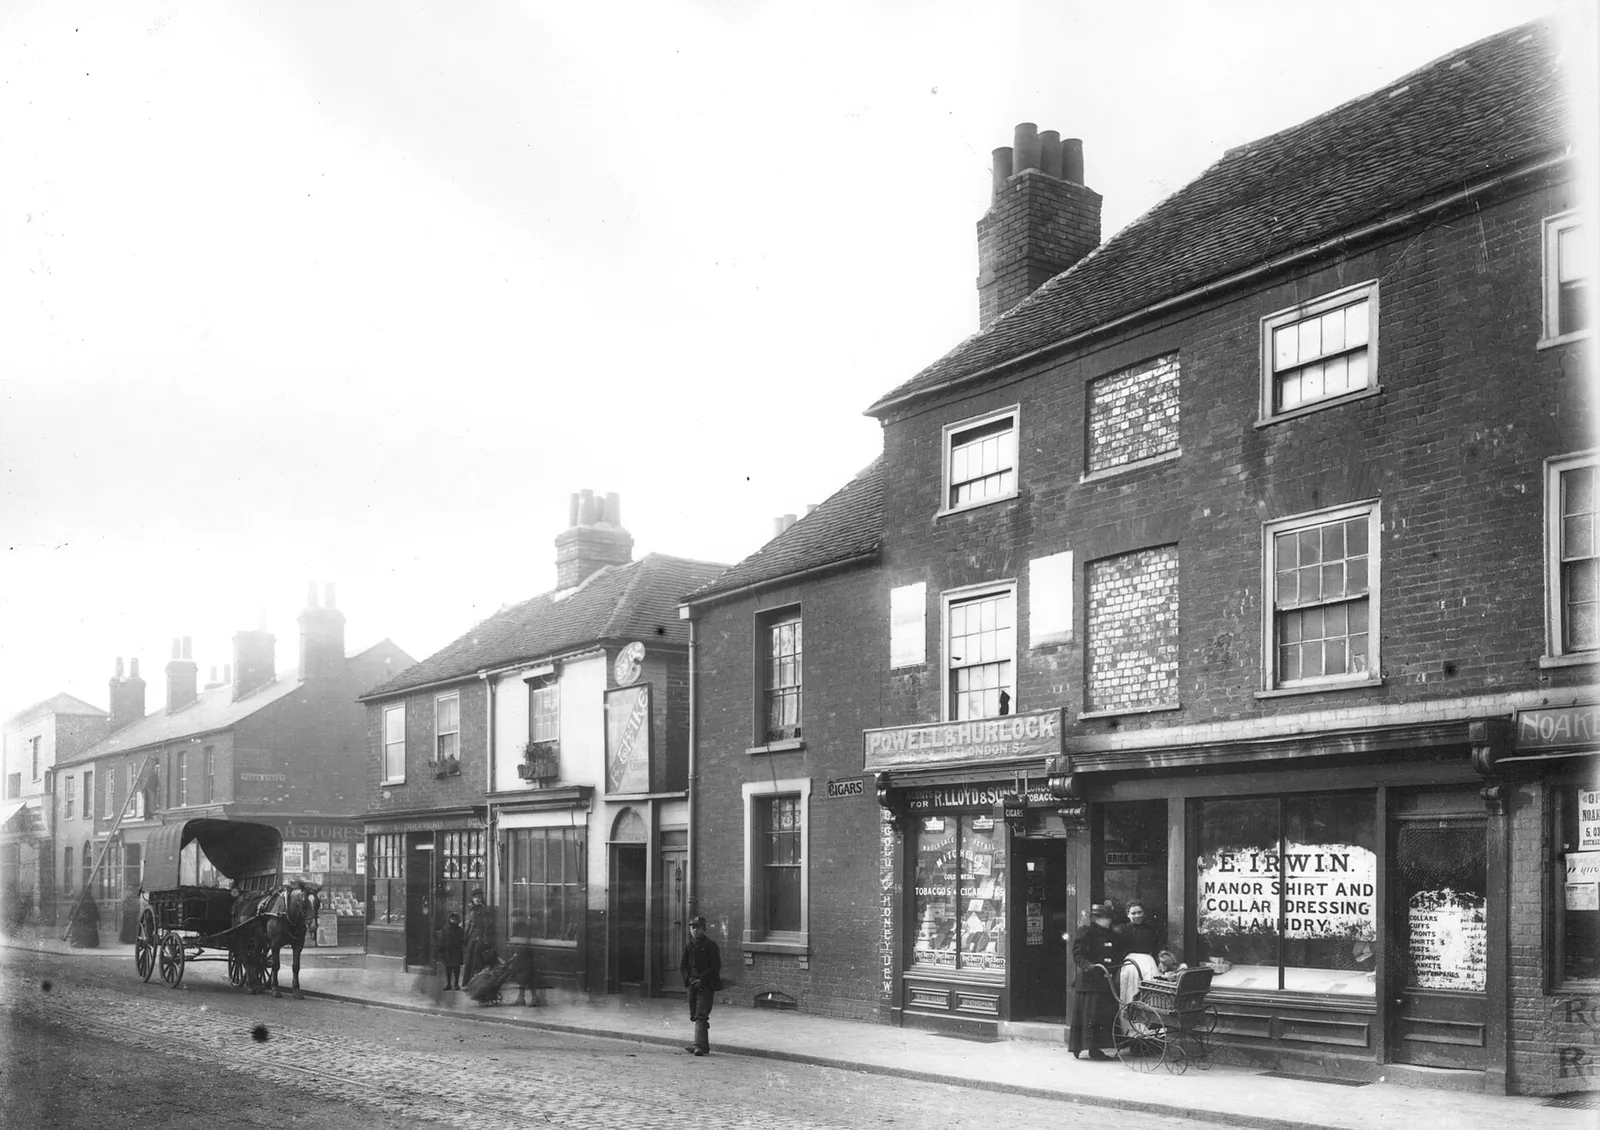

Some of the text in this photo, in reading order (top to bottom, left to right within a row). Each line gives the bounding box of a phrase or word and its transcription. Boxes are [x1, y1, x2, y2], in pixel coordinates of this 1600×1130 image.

[869, 713, 1056, 753] POWELL & HURLOCK
[828, 782, 862, 796] CIGARS
[1005, 809, 1023, 817] CIGARS
[299, 825, 364, 840] STORES
[922, 837, 954, 851] WHOLESALE
[973, 839, 995, 850] RETAIL
[1219, 853, 1355, 873] E. IRWIN.
[915, 887, 951, 896] TOBACCOS
[1067, 884, 1076, 896] 48
[1204, 881, 1374, 897] MANOR SHIRT AND
[1206, 898, 1370, 915] COLLAR DRESSING
[883, 896, 892, 950] HONEY
